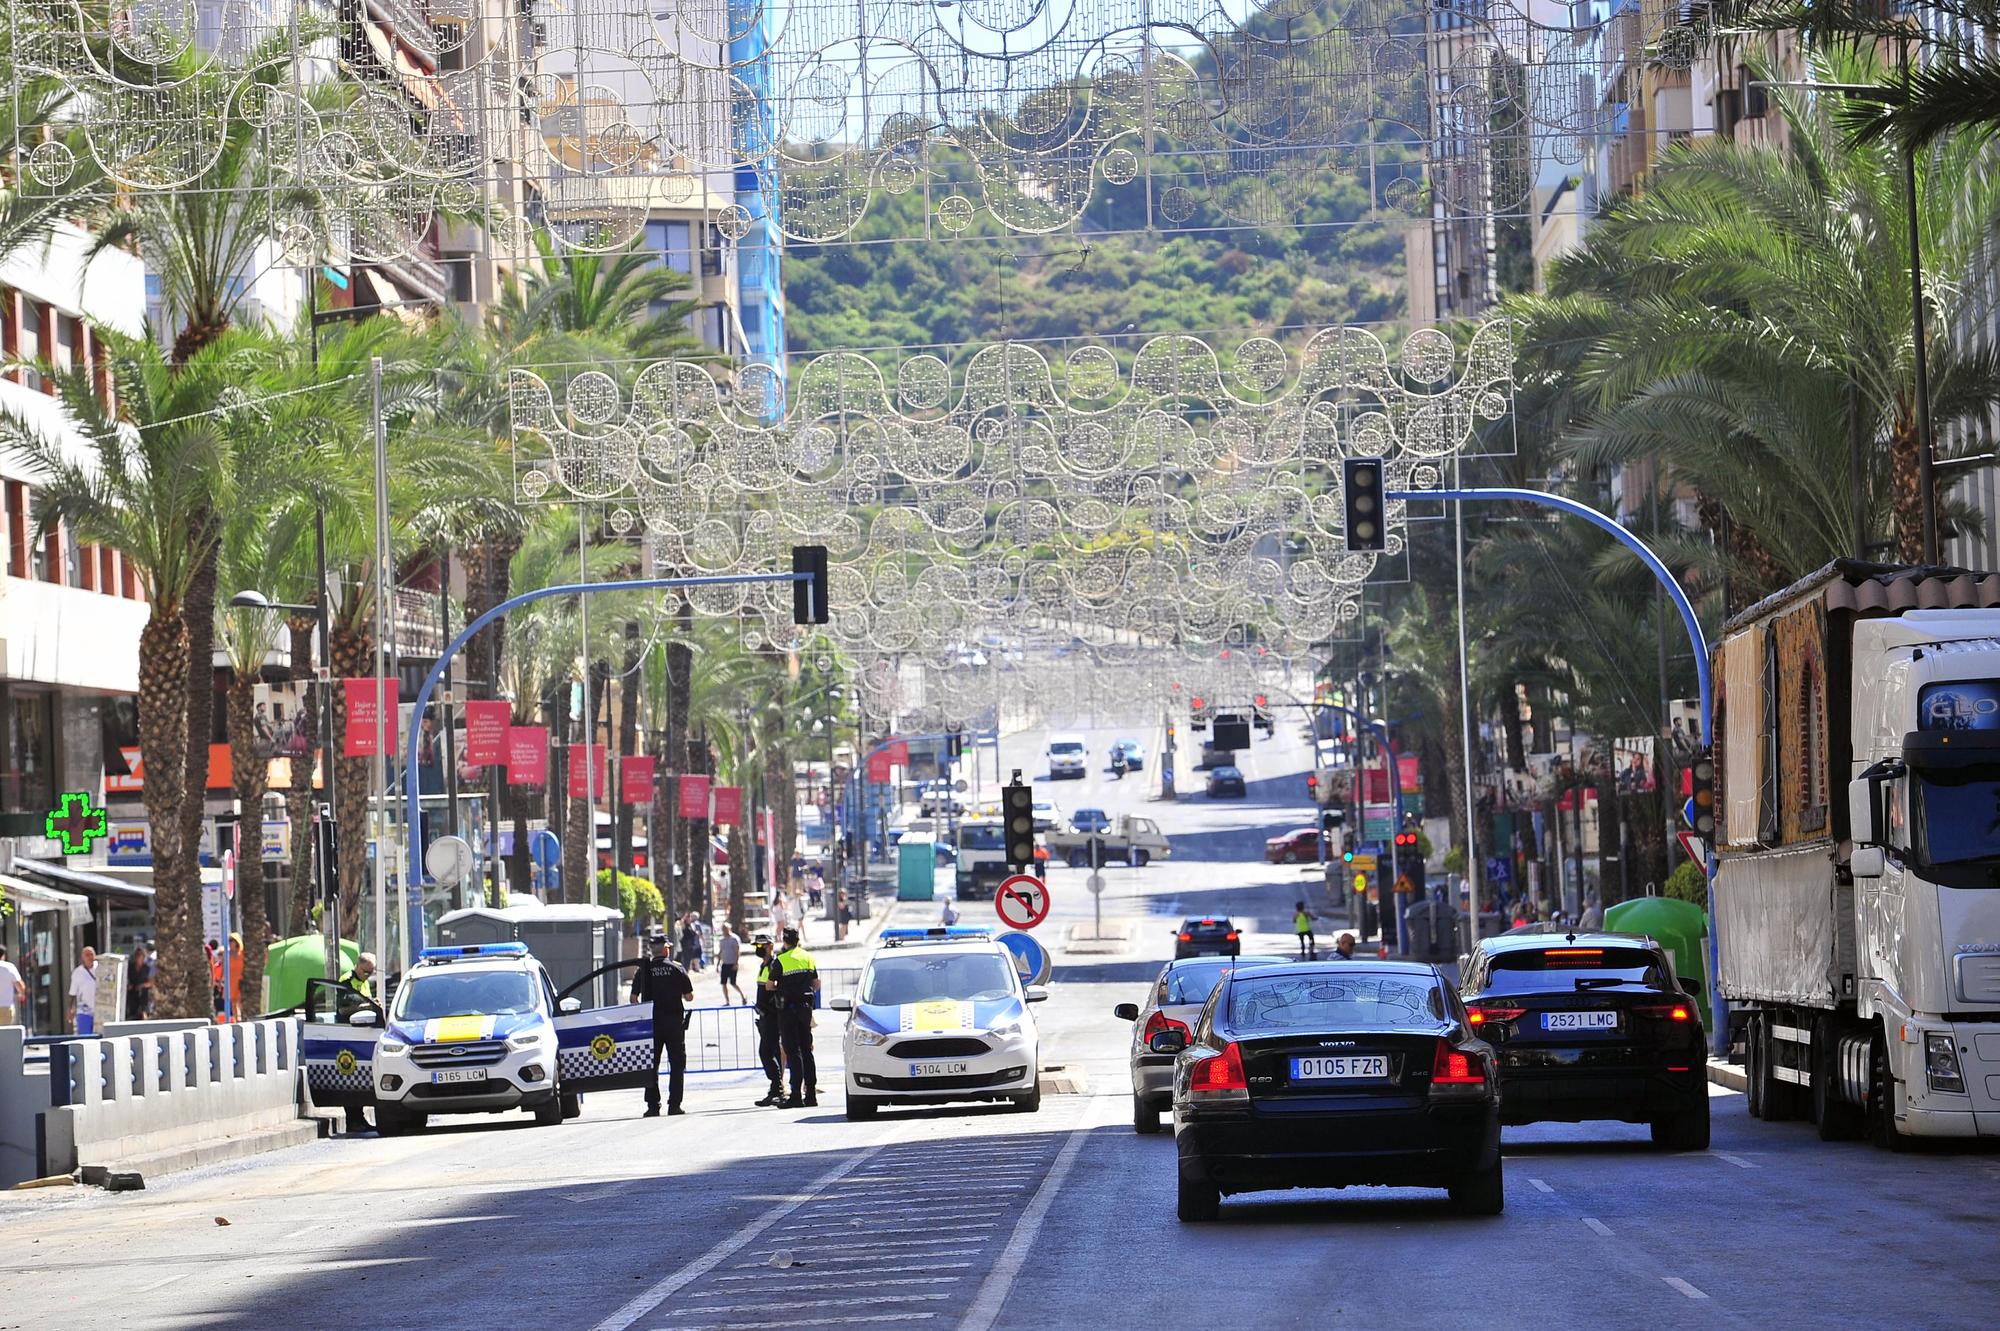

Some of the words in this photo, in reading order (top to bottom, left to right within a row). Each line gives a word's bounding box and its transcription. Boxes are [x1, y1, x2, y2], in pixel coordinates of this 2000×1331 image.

[1550, 1014, 1582, 1027] 2521
[1588, 1013, 1613, 1026] LMC
[915, 1064, 941, 1075] 5104
[947, 1063, 967, 1074] LCM
[1302, 1059, 1345, 1076] 0105
[1351, 1058, 1383, 1075] FZR
[437, 1071, 461, 1082] 8165
[466, 1070, 485, 1080] LCM
